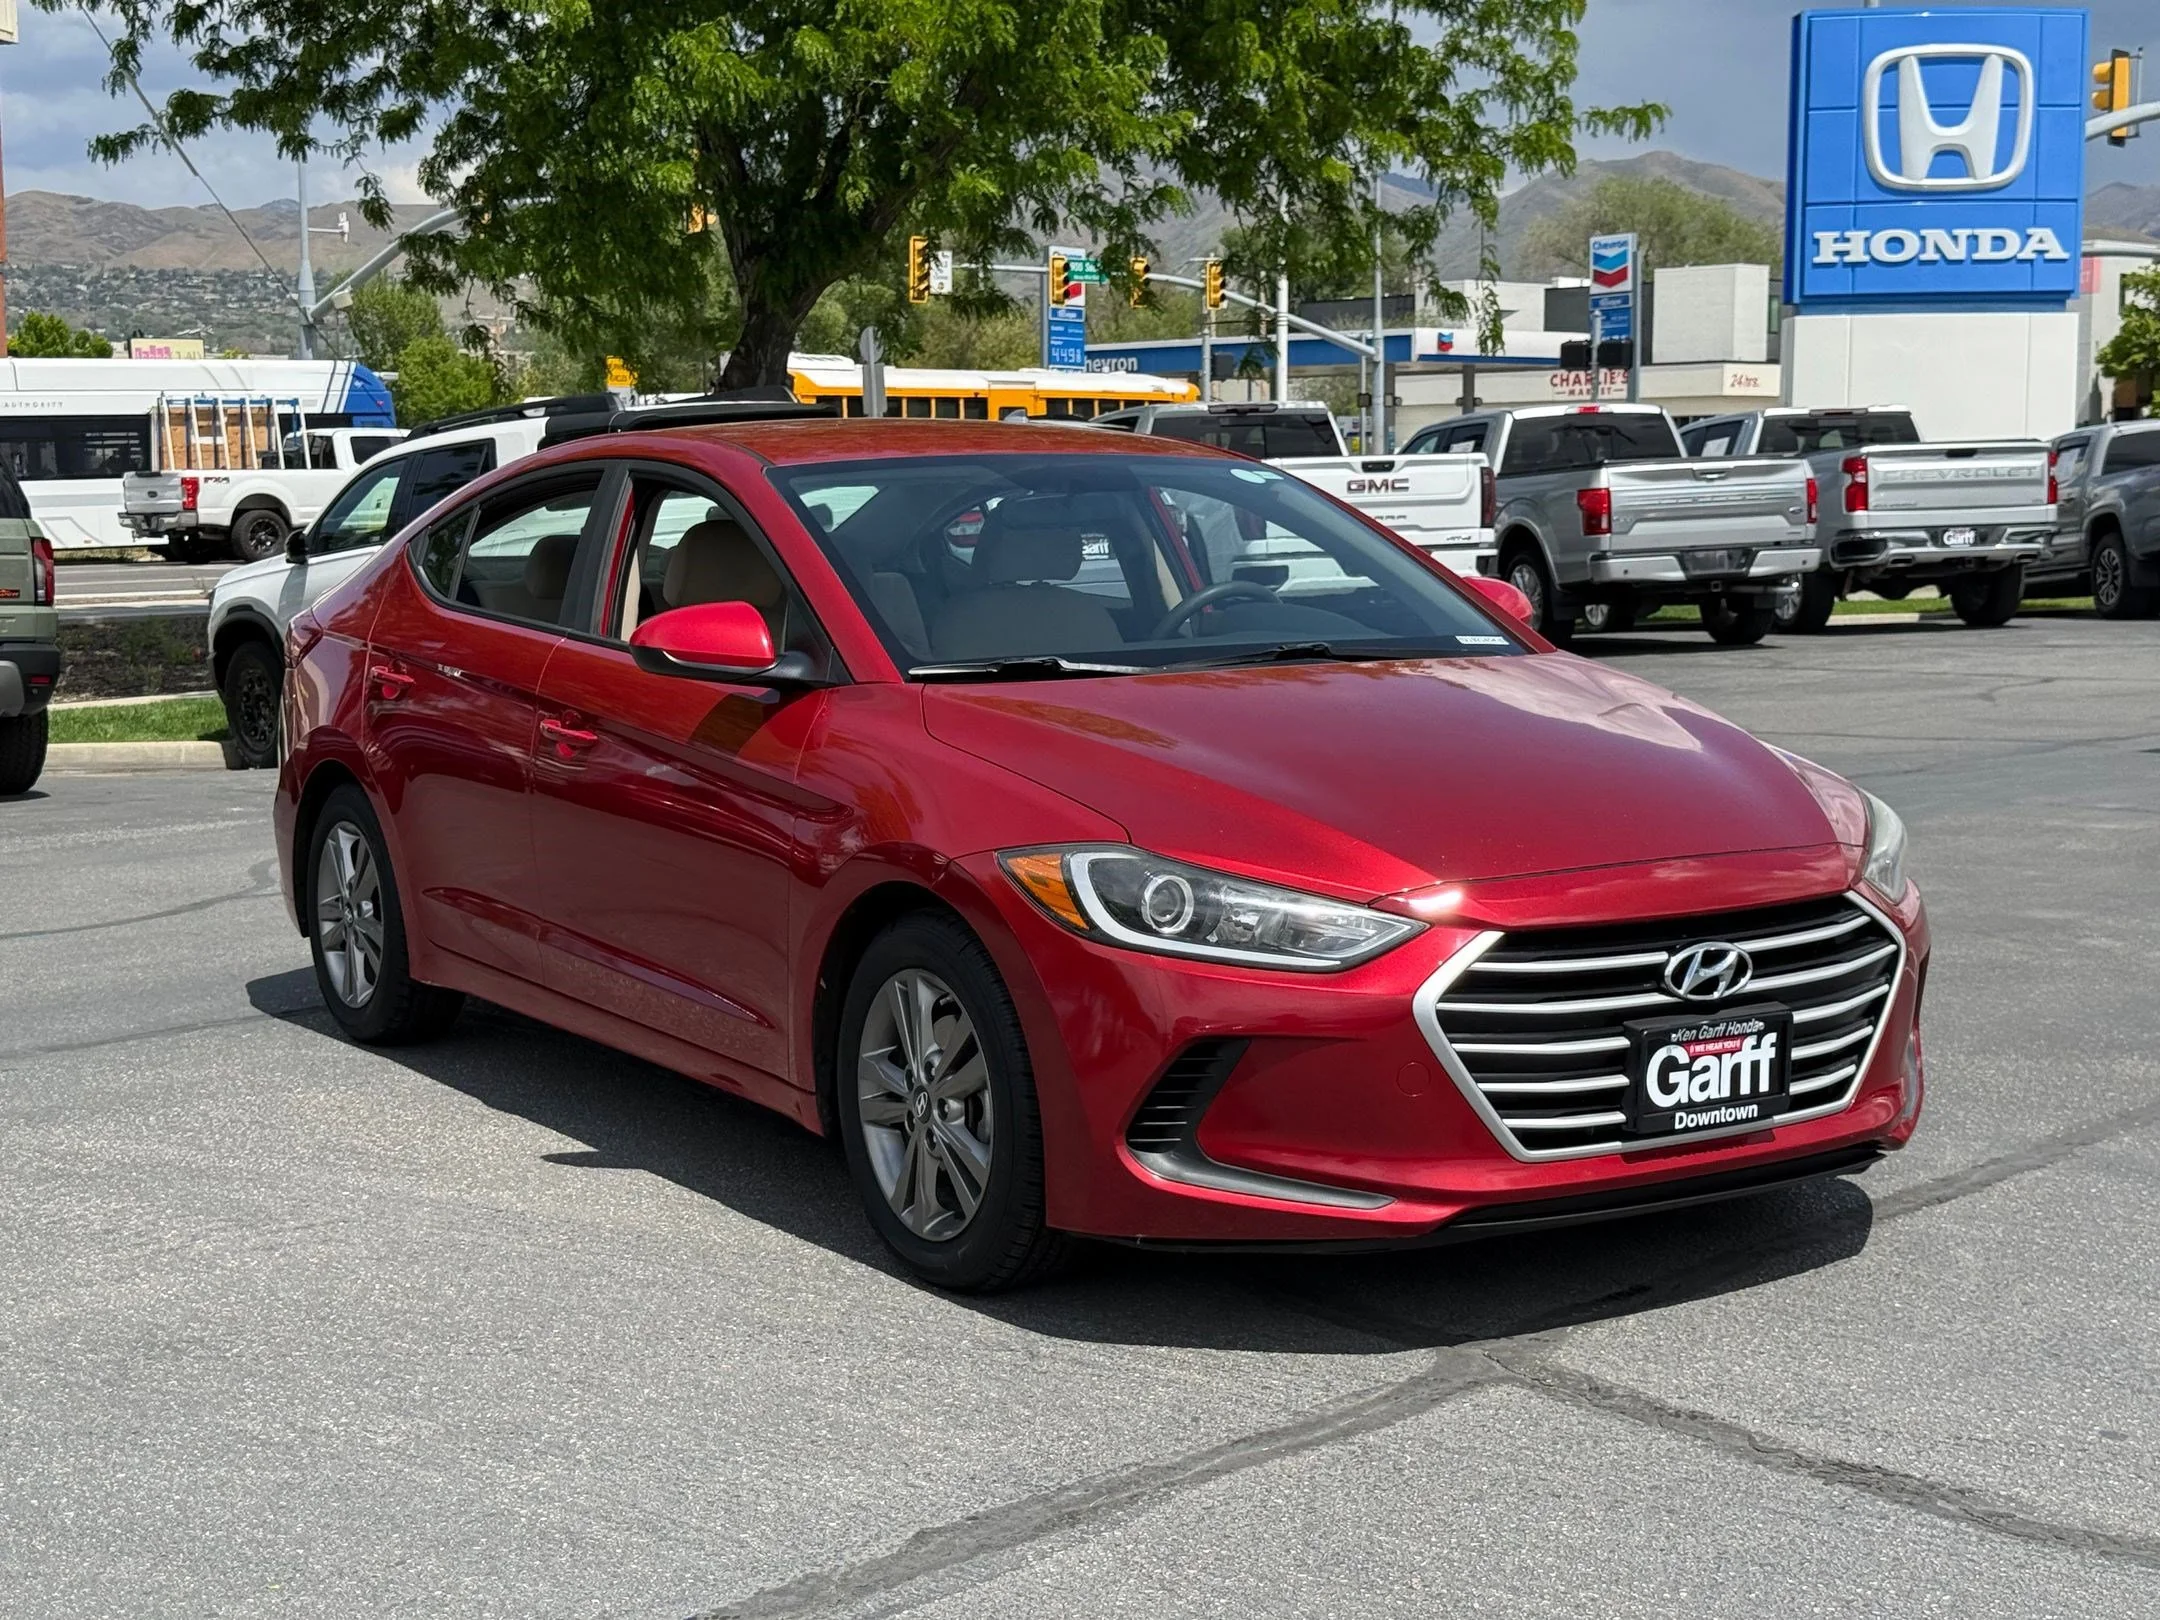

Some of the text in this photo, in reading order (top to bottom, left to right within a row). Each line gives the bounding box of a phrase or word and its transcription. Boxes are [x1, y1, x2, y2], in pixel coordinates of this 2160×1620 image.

[1812, 228, 2070, 263] HONDA
[1083, 356, 1138, 372] hevron
[1550, 368, 1629, 388] CHARIE'S
[1567, 386, 1613, 397] MARET
[1883, 466, 2038, 482] CHEVROLET
[1346, 478, 1410, 495] GMC
[1676, 1019, 1759, 1041] Ken Garff Honda
[1646, 1032, 1778, 1108] Garff
[1675, 1104, 1758, 1129] Downtown
